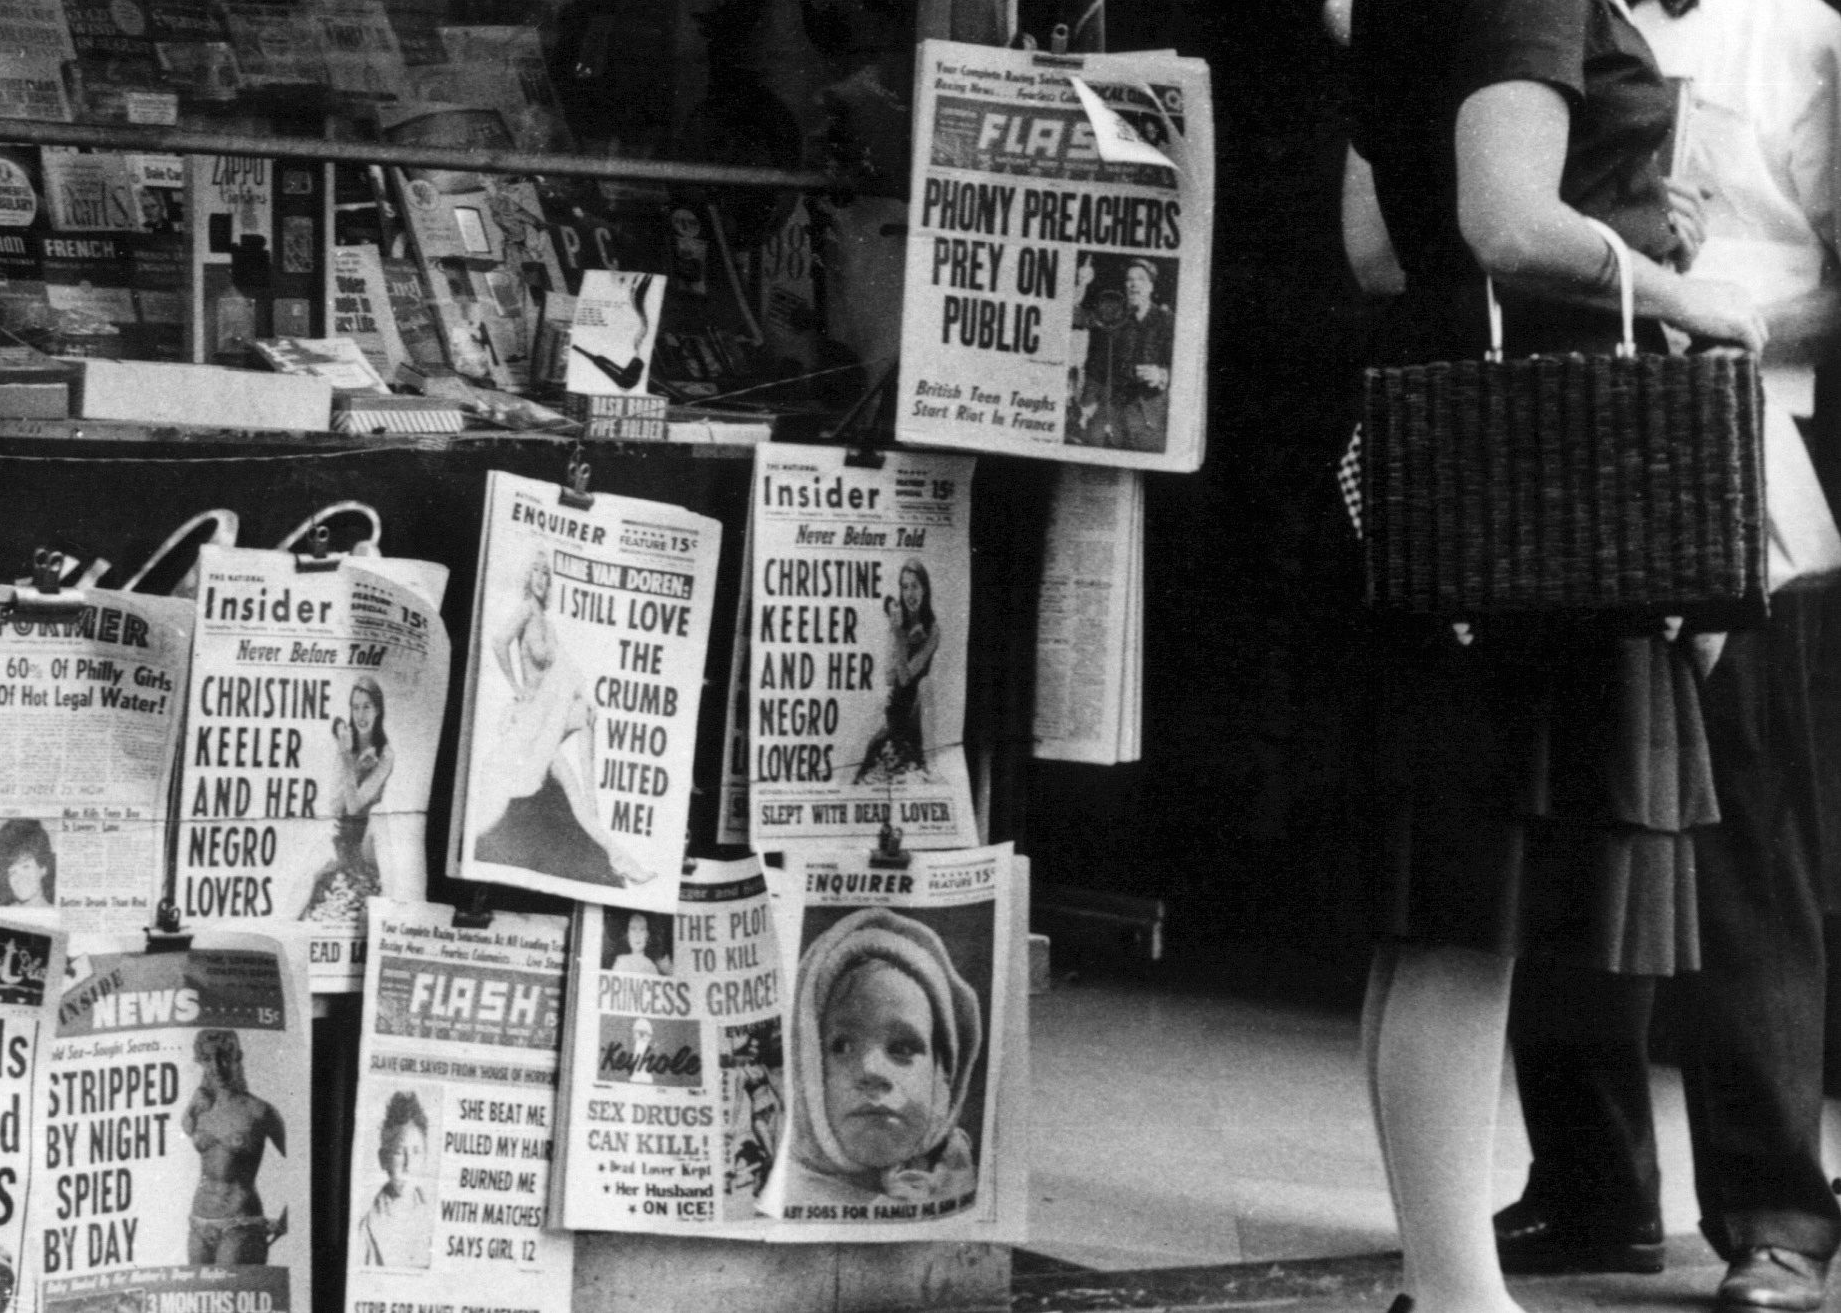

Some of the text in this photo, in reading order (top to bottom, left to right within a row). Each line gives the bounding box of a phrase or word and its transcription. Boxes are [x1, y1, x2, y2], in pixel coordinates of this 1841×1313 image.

[922, 176, 1181, 251] PHONY PREACHERS
[44, 238, 115, 260] FRENCH
[932, 236, 1059, 300] PREY ON
[941, 294, 1042, 355] PUBLIC
[763, 475, 880, 510] Insider
[511, 502, 607, 545] ENQUIRER
[764, 558, 882, 599] CHRISTINE
[204, 587, 333, 623] Insider
[559, 584, 691, 638] I STILL LOVE
[761, 605, 857, 644] KEELER
[619, 639, 664, 675] THE
[760, 651, 874, 691] AND HER
[21, 686, 48, 707] Hot
[54, 686, 93, 712] Legal
[100, 688, 166, 715] Water!
[200, 675, 331, 720] CHRISTINE
[594, 676, 678, 717] CRUMB
[759, 697, 839, 736] NEGRO
[194, 726, 301, 769] KEELER
[606, 717, 667, 757] WHO
[599, 757, 668, 797] JILTED
[758, 743, 833, 783] LOVERS
[192, 776, 318, 819] AND HER
[611, 799, 654, 837] ME!
[188, 825, 277, 869] NEGRO
[186, 875, 272, 918] LOVERS
[692, 942, 760, 973] TO KILL
[92, 988, 200, 1029] NEWS
[409, 973, 540, 1027] FLASH
[597, 972, 779, 1017] PRINCESS GRACE!
[600, 1041, 701, 1076] Keyhole
[47, 1061, 180, 1119] STRIPPED
[490, 1100, 522, 1124] BEAT
[46, 1112, 171, 1170] BY NIGHT
[56, 1167, 132, 1221] SPIED
[460, 1166, 536, 1193] BURNED ME
[614, 1182, 713, 1198] Her Husband
[642, 1199, 714, 1217] ON ICE!
[43, 1217, 138, 1274] BY DAY
